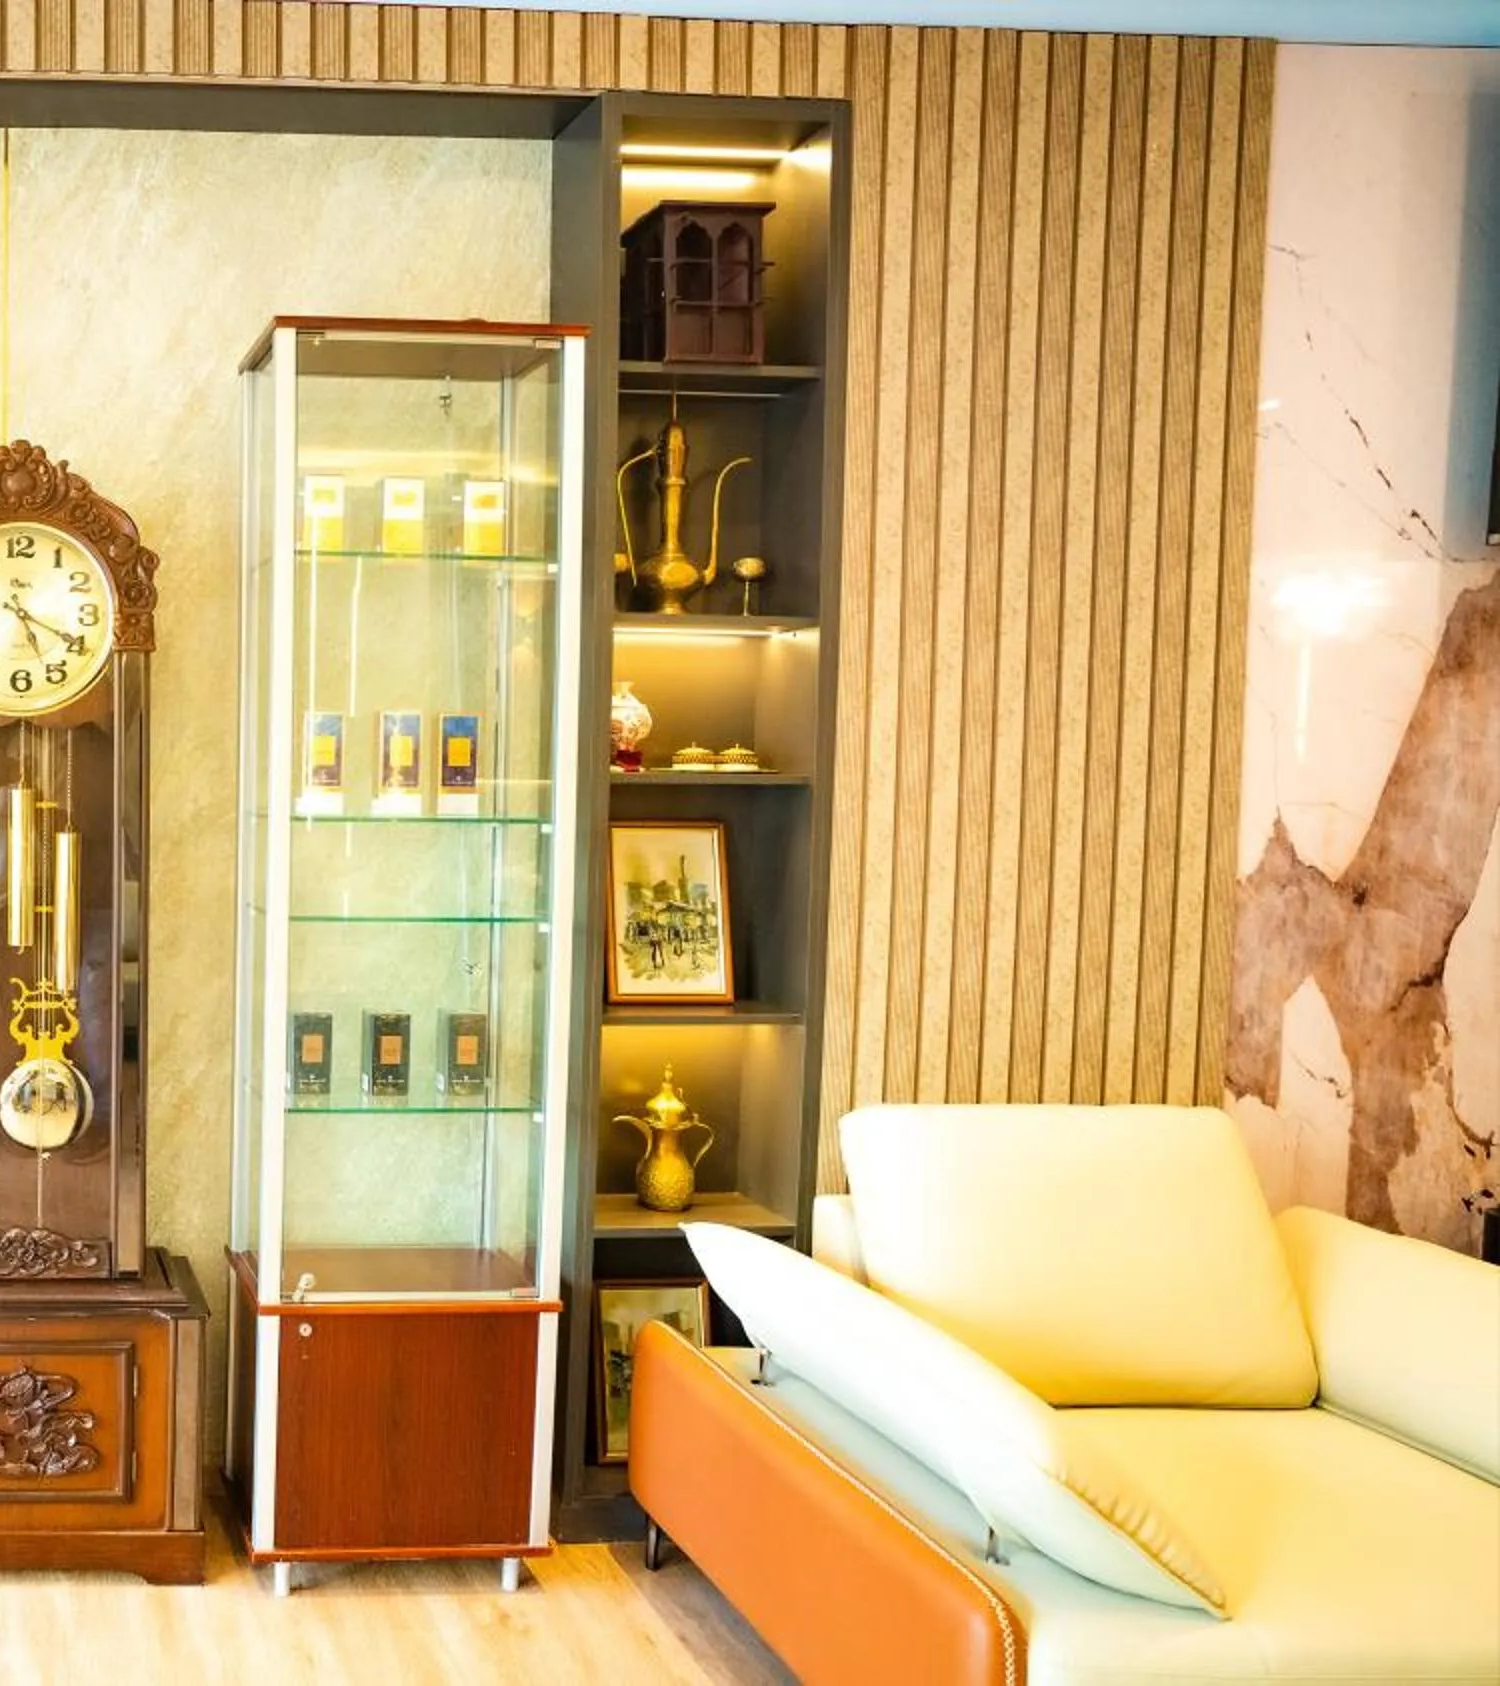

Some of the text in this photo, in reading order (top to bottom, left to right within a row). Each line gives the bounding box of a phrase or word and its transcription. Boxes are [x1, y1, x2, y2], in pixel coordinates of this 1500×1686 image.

[6, 535, 36, 559] 12
[53, 547, 63, 569] 1
[69, 571, 92, 594] 2
[78, 603, 100, 627] 3
[66, 634, 87, 657] 4
[9, 669, 33, 693] 6
[45, 659, 68, 685] 5
